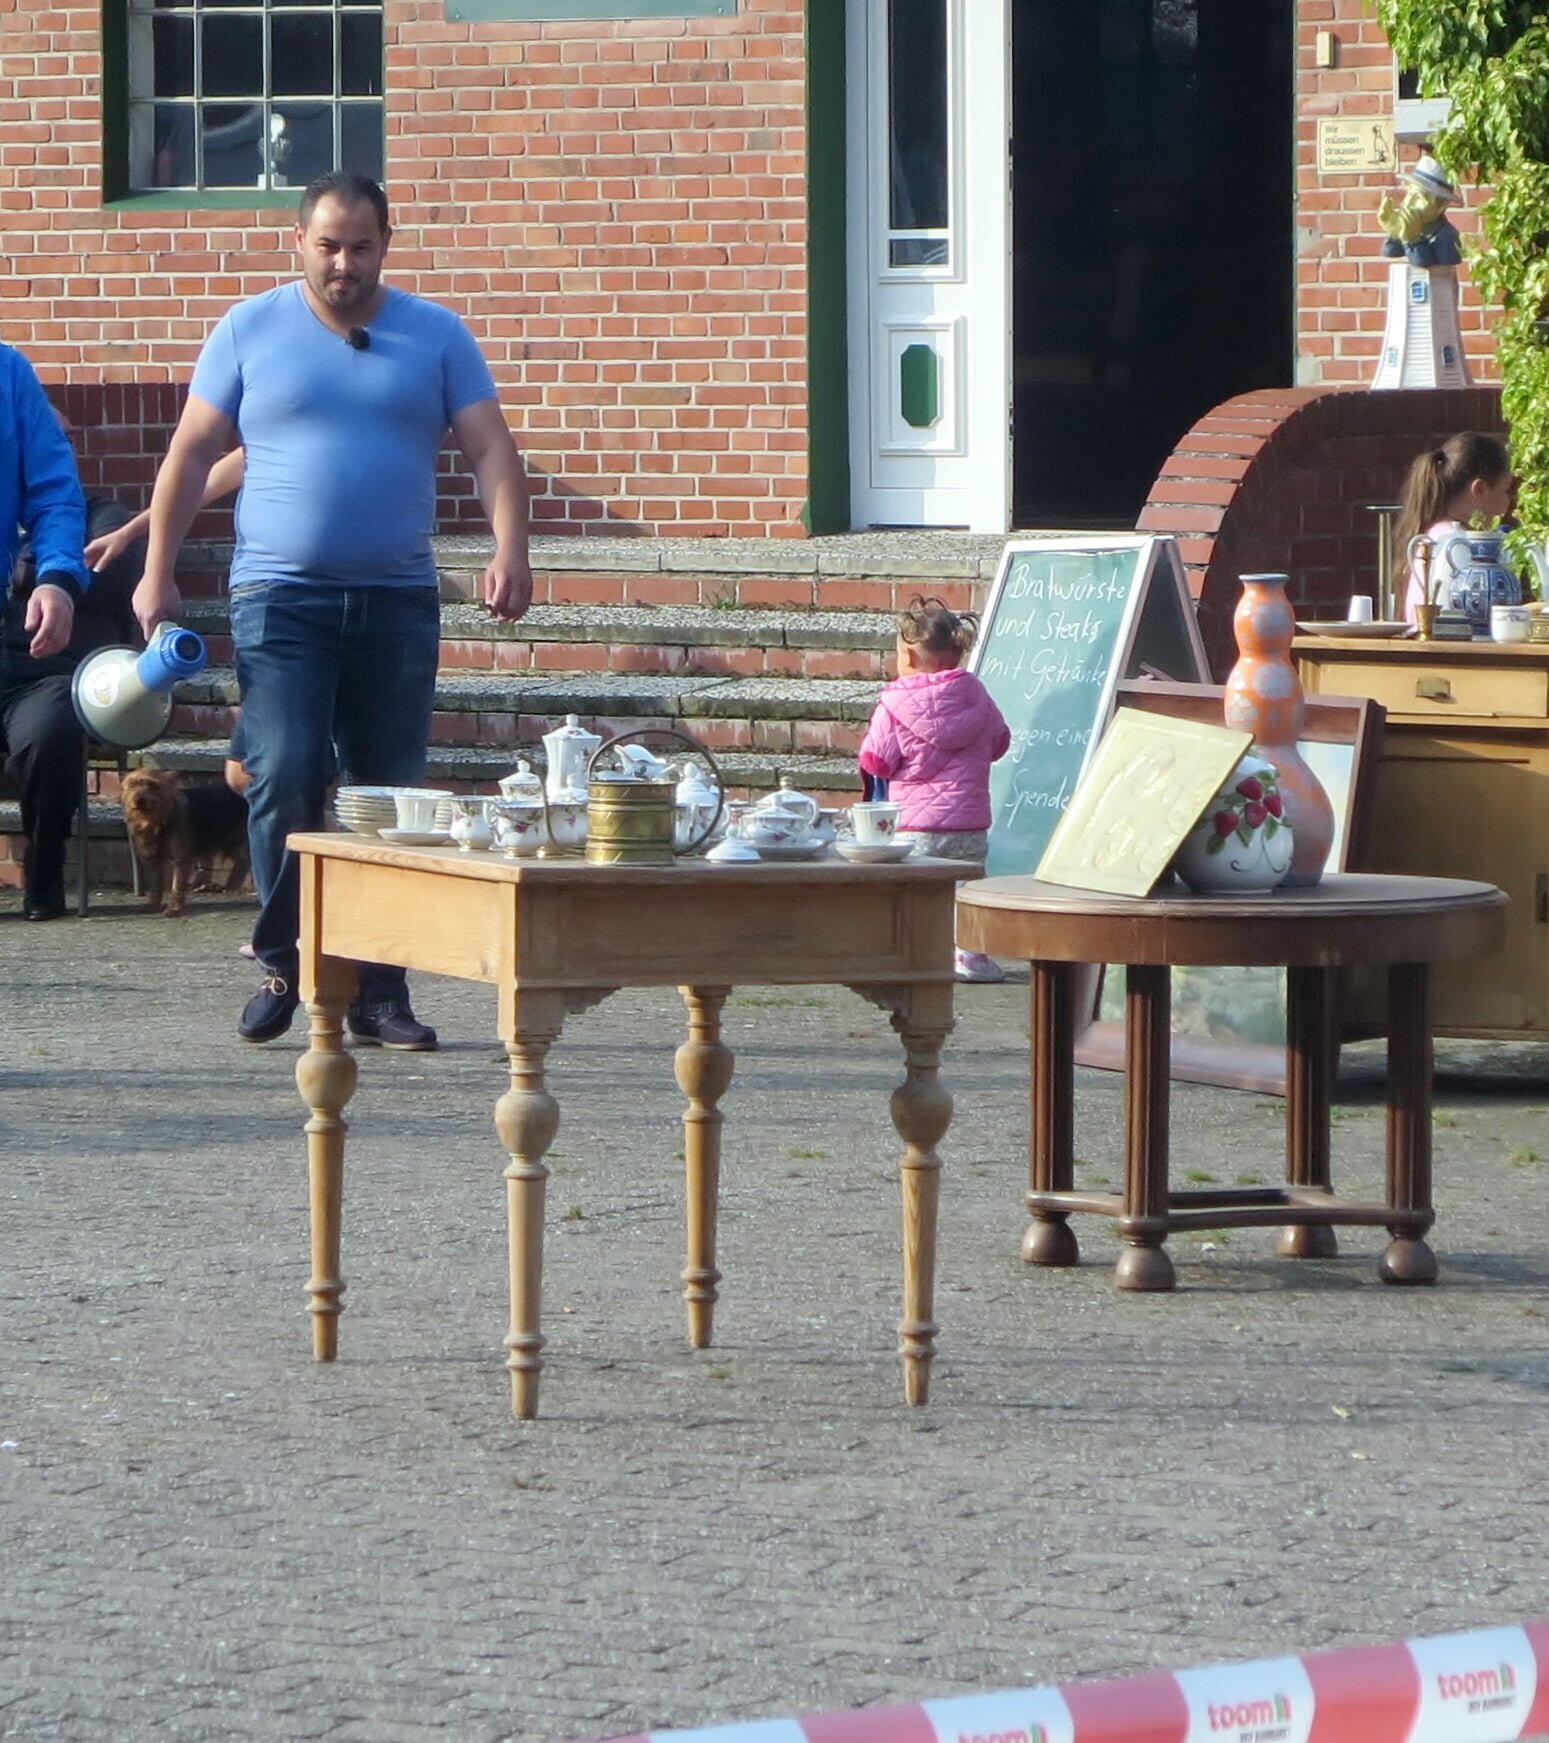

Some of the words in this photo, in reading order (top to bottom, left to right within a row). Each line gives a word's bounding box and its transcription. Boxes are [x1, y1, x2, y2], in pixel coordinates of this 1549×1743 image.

[1325, 125, 1340, 133] Wir
[1325, 135, 1360, 144] müssen
[995, 608, 1036, 638] und
[1040, 608, 1103, 645] Steaks
[981, 648, 1025, 681] mit
[1010, 728, 1052, 764] egen
[1004, 767, 1071, 830] Spende
[1437, 1668, 1499, 1700] toom
[1208, 1699, 1274, 1732] toom
